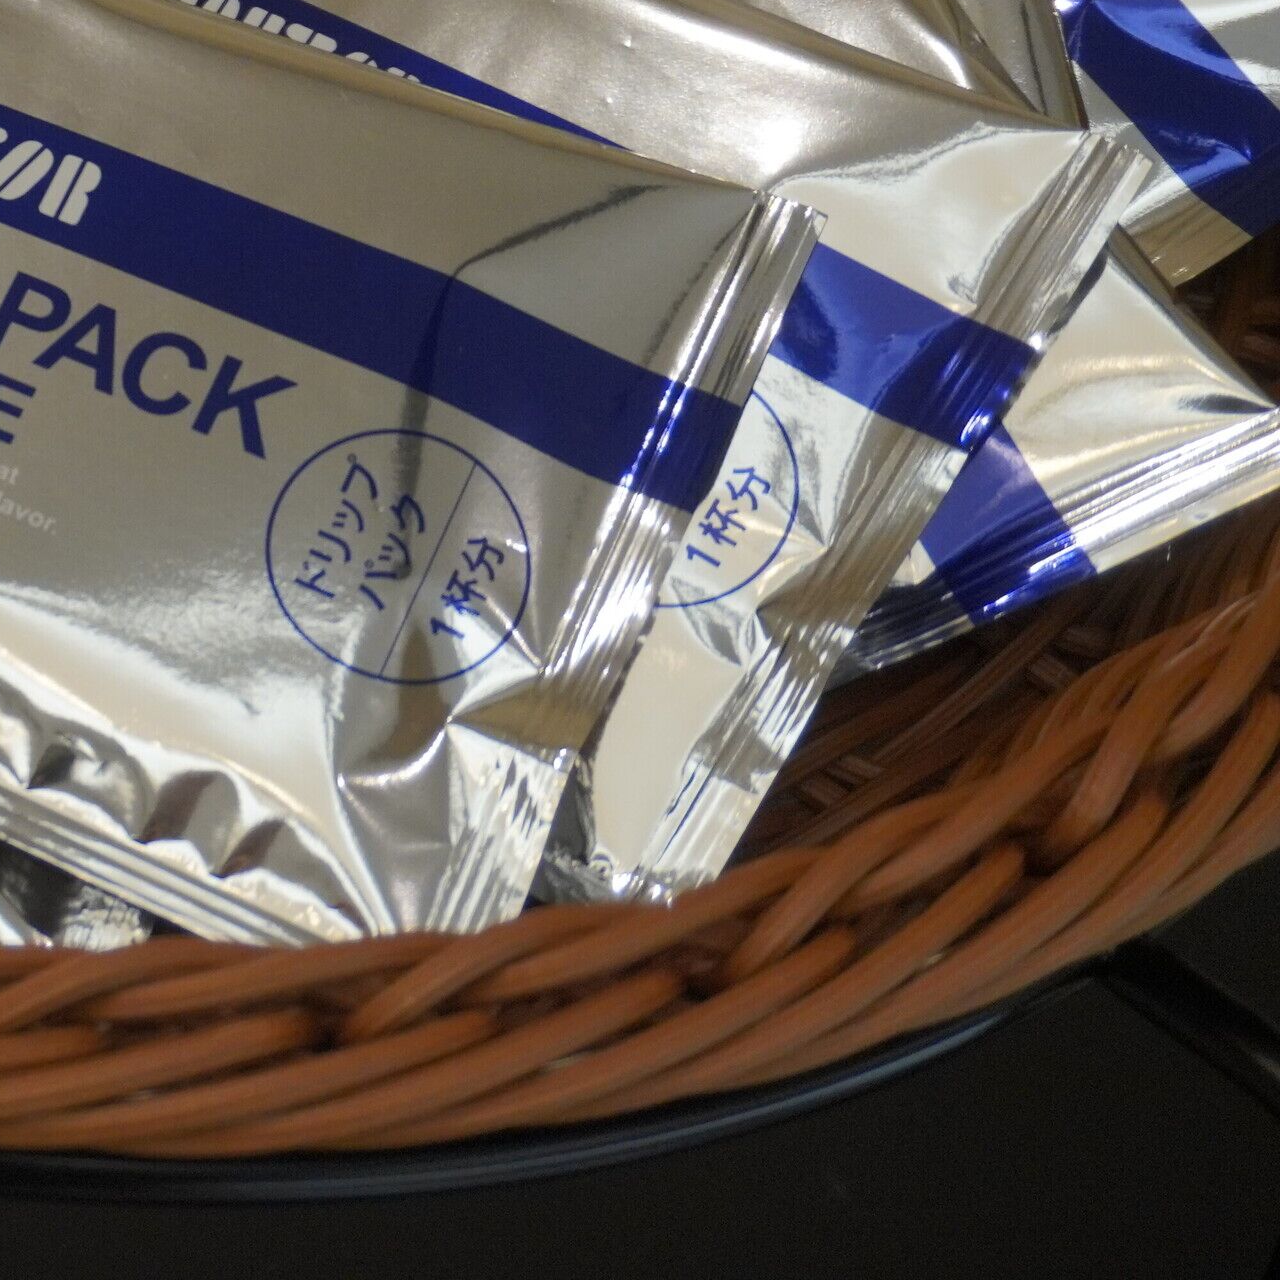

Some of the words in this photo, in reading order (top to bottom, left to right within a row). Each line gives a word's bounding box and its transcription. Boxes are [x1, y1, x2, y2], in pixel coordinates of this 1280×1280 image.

[294, 453, 378, 600] ドリップ
[358, 494, 425, 611] パック
[686, 467, 771, 568] 1杯分
[430, 536, 504, 639] 1杯分
